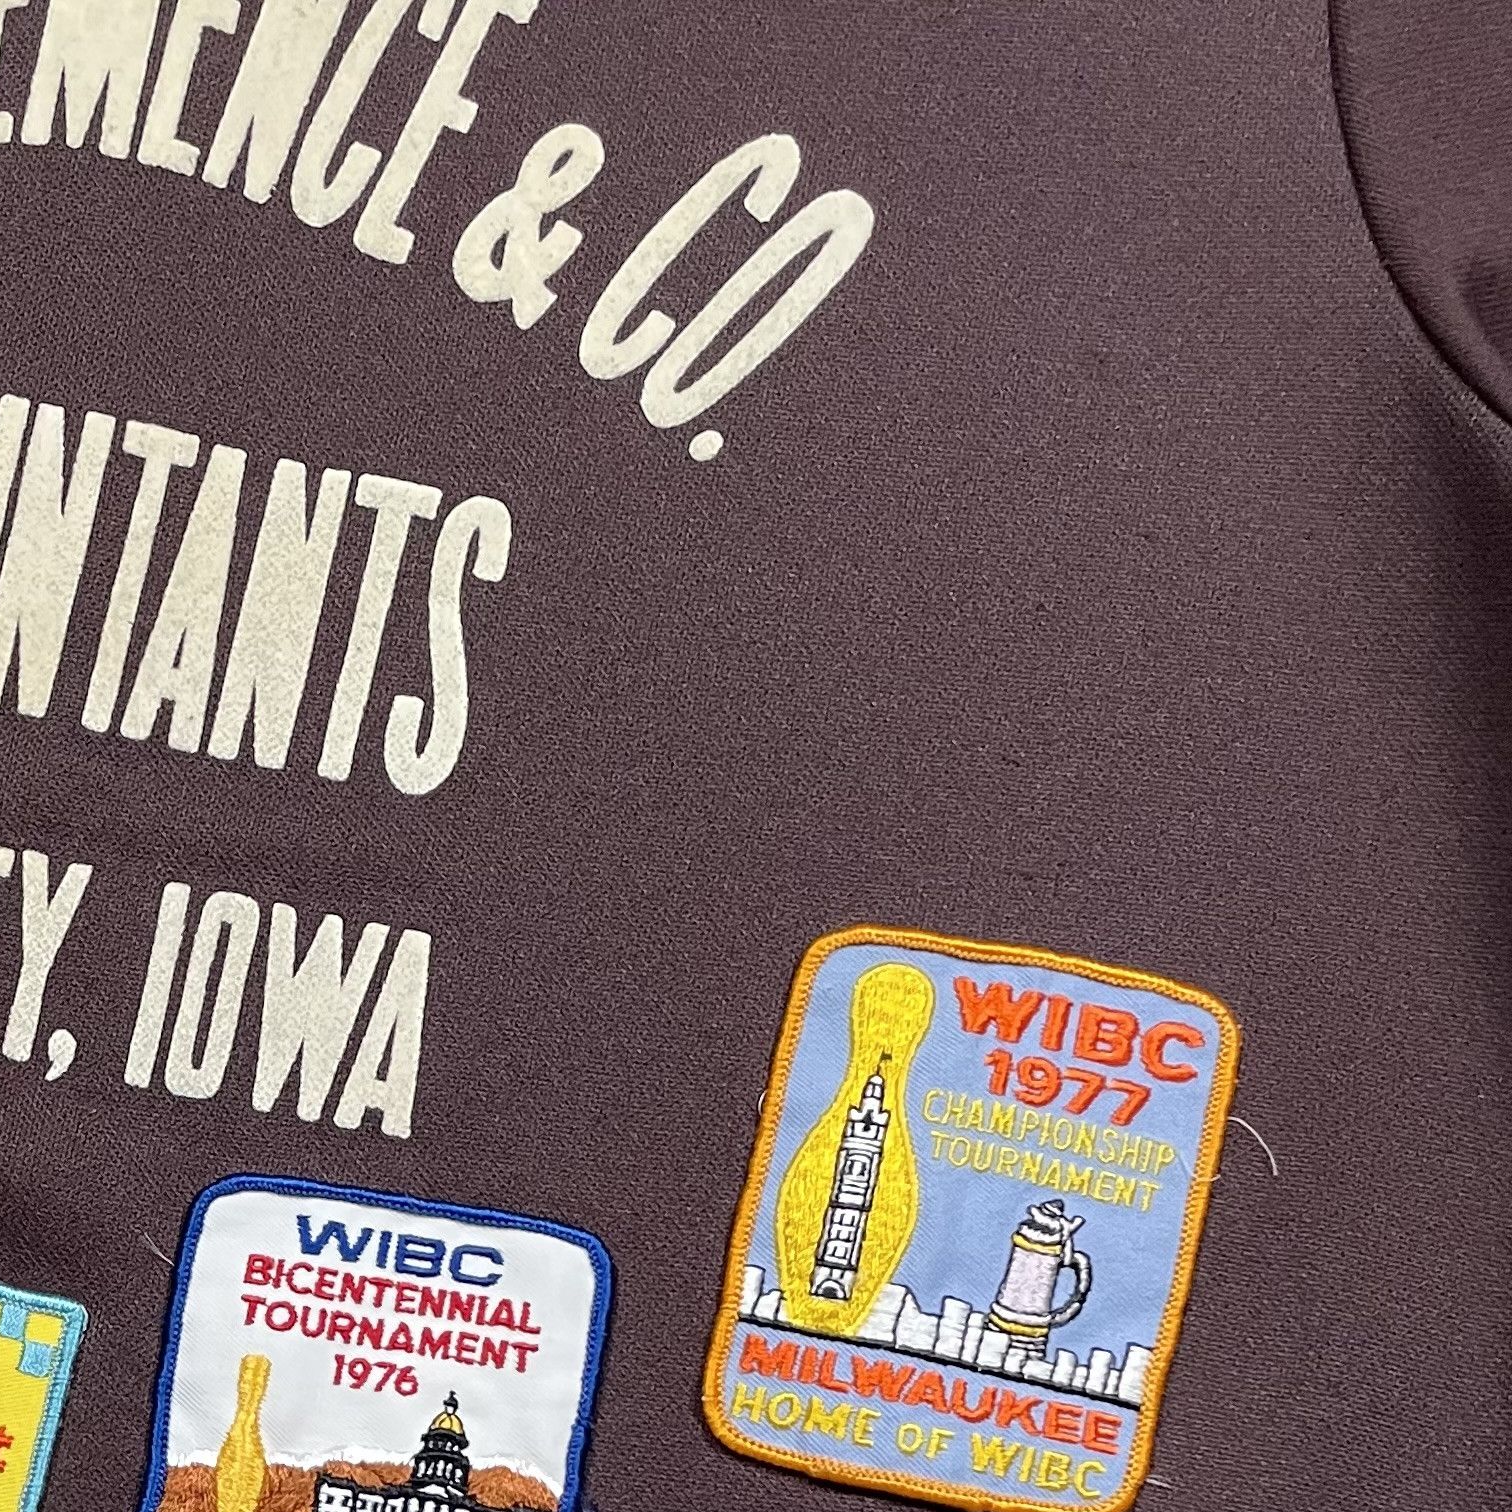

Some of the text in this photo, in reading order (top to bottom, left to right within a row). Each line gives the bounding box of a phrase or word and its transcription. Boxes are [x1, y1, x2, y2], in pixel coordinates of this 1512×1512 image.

[452, 123, 604, 329] &
[578, 133, 875, 462] CO.
[123, 882, 431, 1138] IOWA
[953, 976, 1206, 1083] WIBC
[984, 1047, 1153, 1127] 1977
[921, 1087, 1177, 1173] CHAMPIONSHIP
[930, 1130, 1161, 1212] TOURNAMENT
[295, 1213, 506, 1288] WIBC
[240, 1294, 540, 1375] TOURNAMENT
[242, 1253, 543, 1335] BICENTENNIAL
[332, 1353, 421, 1397] 1976
[738, 1333, 1124, 1456] MILWAUKEE
[731, 1382, 1108, 1499] HOME OF WIBC
